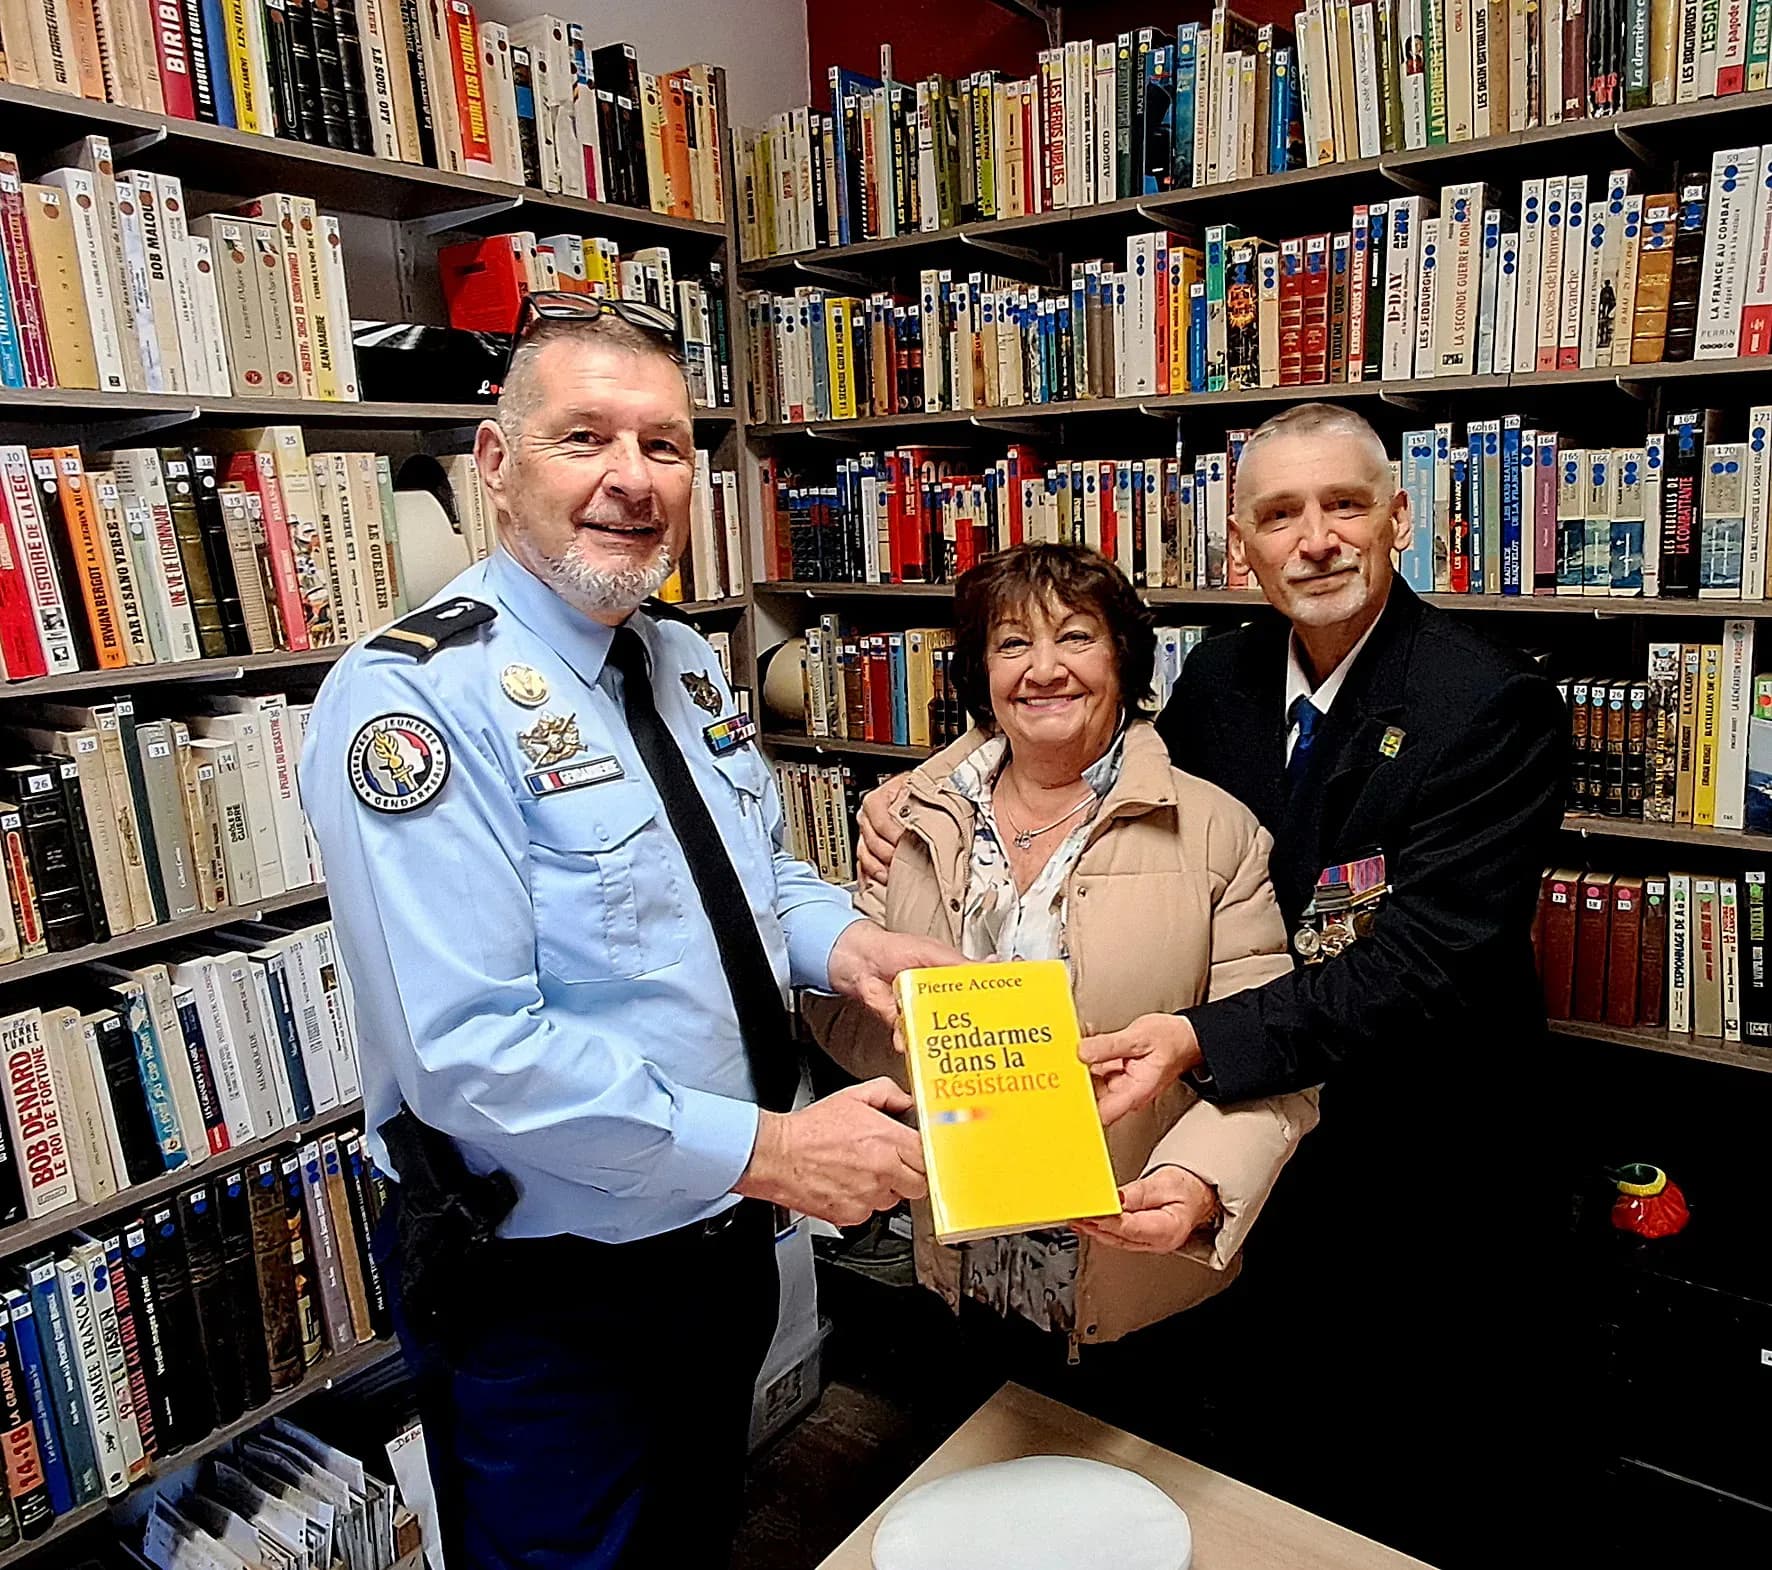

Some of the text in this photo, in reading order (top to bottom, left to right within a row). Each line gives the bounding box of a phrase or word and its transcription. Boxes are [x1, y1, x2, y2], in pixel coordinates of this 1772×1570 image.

[1699, 0, 1719, 54] L'ESCA
[1725, 5, 1740, 57] La pagode
[459, 18, 476, 72] COLONEL
[1631, 11, 1644, 87] La dernière
[1682, 6, 1696, 83] LES BAGNARDS
[371, 47, 382, 64] LE
[1476, 9, 1487, 109] LES DEUX BATAILLONS
[374, 66, 387, 95] SOUS
[465, 74, 480, 97] DES
[1050, 77, 1061, 98] LES
[1050, 101, 1063, 137] HEROS
[4, 180, 16, 191] 71
[75, 180, 88, 191] 73
[118, 186, 132, 197] 75
[138, 180, 151, 189] 77
[1687, 189, 1699, 197] 58
[44, 193, 57, 203] 72
[1592, 213, 1603, 221] 54
[1718, 197, 1729, 239] COMBAT
[142, 201, 164, 279] BOB MALOU
[1457, 250, 1468, 286] GUERRE
[1543, 226, 1559, 339] Les voies de l'honneu
[1712, 262, 1724, 302] FRANCE
[1388, 273, 1402, 321] D-DAY
[1564, 270, 1578, 339] La revanche
[1454, 291, 1466, 331] SECONDE
[1710, 306, 1719, 319] LA
[1419, 329, 1429, 349] LES
[1454, 334, 1464, 346] LA
[320, 349, 331, 371] JEAN
[8, 453, 19, 461] 10
[66, 462, 77, 471] 12
[202, 458, 212, 466] 18
[40, 466, 50, 474] 11
[103, 487, 114, 496] 13
[130, 512, 140, 520] 14
[1663, 477, 1678, 554] LES REBELLES DE
[1676, 478, 1692, 554] LA COMBATTANTE
[11, 475, 54, 605] HISTOIRE DE LA LEG
[367, 524, 379, 540] LE
[163, 562, 180, 573] DE
[166, 573, 182, 588] VIE
[88, 567, 116, 647] ERWAN BERGOT
[124, 602, 138, 617] LE
[129, 620, 144, 644] PAR
[119, 704, 131, 713] 30
[103, 719, 115, 729] 29
[384, 719, 438, 749] JEUNESSE
[80, 740, 94, 750] 28
[179, 734, 188, 743] 32
[152, 746, 166, 755] 31
[276, 754, 285, 764] DU
[64, 766, 77, 776] 27
[33, 780, 49, 790] 26
[375, 759, 444, 808] GENDARMERIE
[5, 816, 18, 826] 25
[232, 804, 245, 841] GUERRE
[1674, 919, 1685, 930] DE
[918, 976, 1023, 994] Pierre Accoce
[932, 1011, 972, 1030] Les
[2, 1021, 39, 1042] PIERRE
[926, 1025, 1052, 1058] gendarmes
[4, 1033, 40, 1051] LUNEL
[940, 1048, 1024, 1074] dans la
[934, 1072, 1060, 1099] Résistance
[10, 1052, 53, 1187] BOB DENARD
[32, 1044, 68, 1179] LE ROI DE FORTUNE
[39, 1269, 51, 1280] 14
[74, 1294, 109, 1423] L'ARMÉE FRANÇAI
[10, 1430, 39, 1488] 14-18
